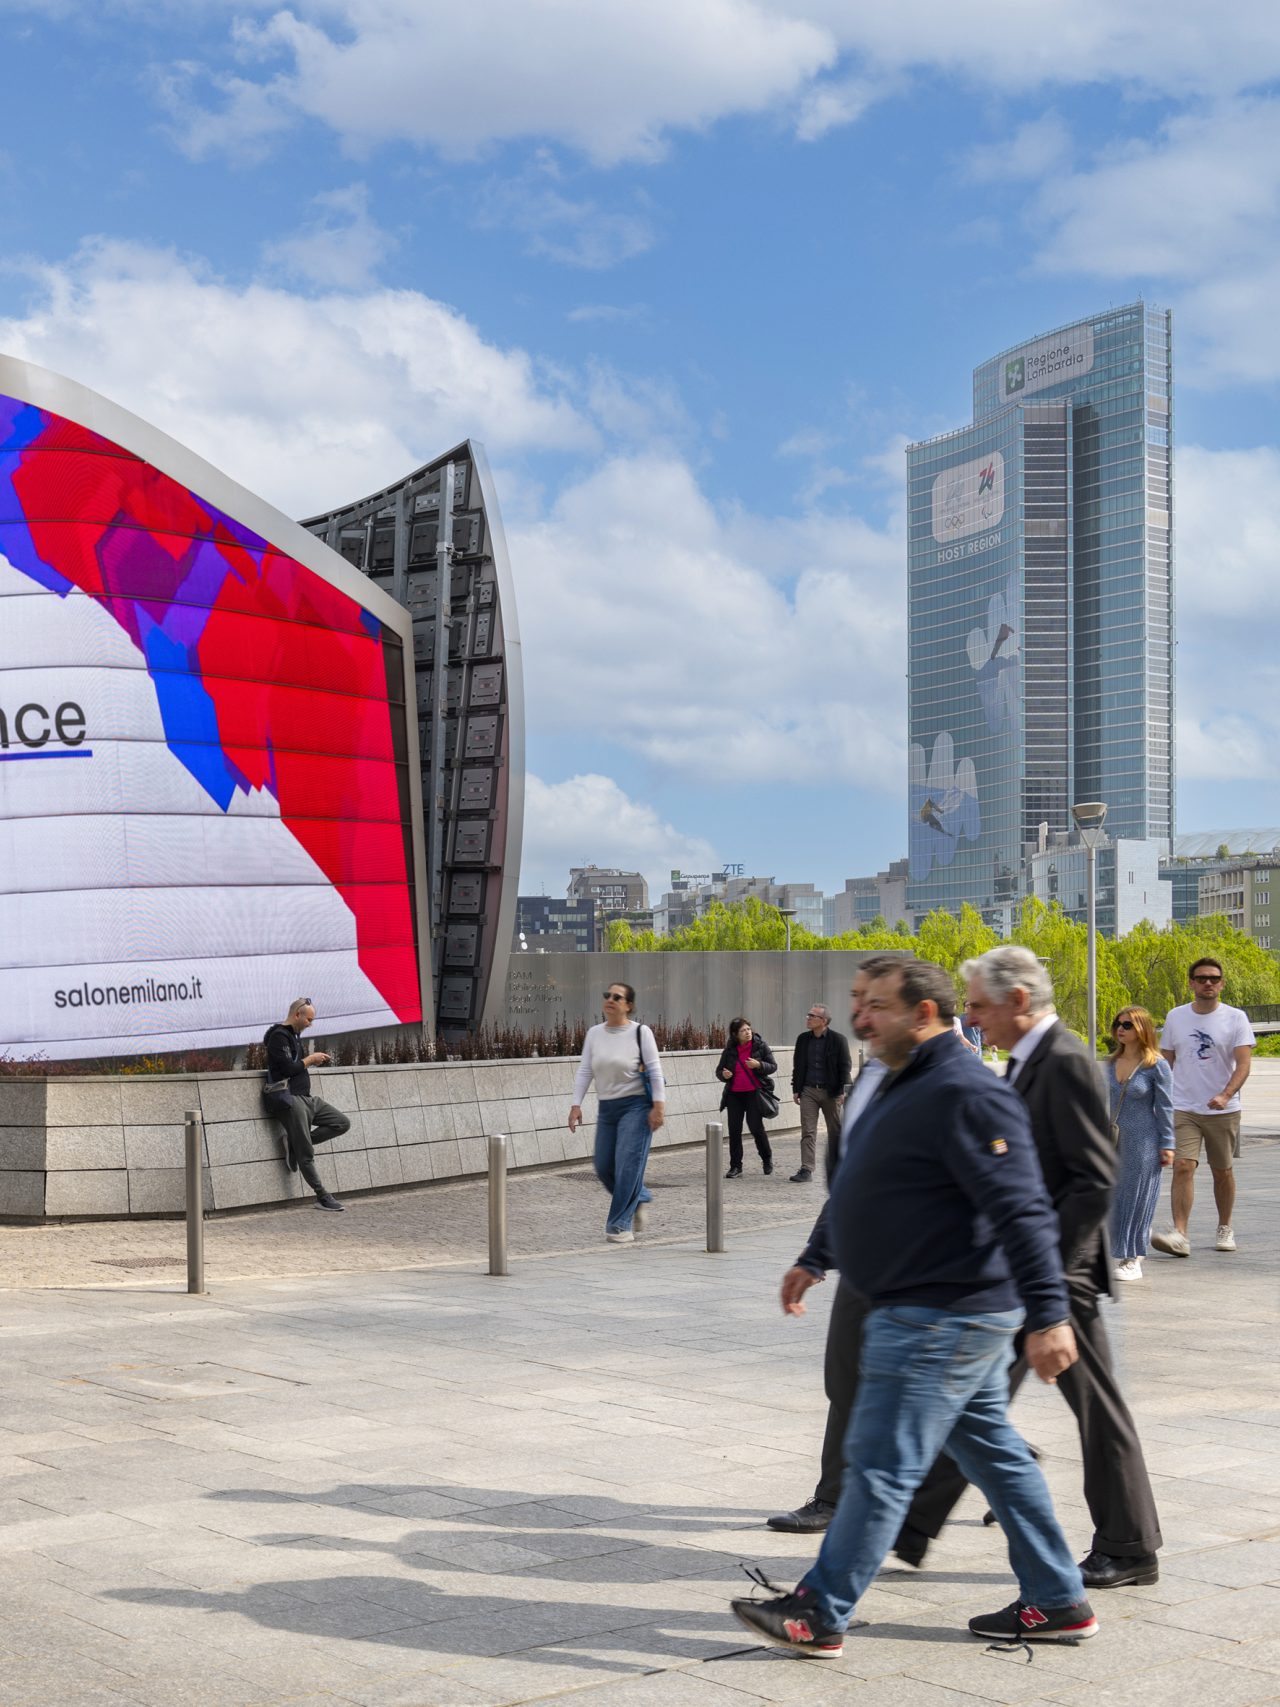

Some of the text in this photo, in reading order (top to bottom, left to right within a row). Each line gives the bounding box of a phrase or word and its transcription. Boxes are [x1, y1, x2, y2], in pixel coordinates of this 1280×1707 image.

[1026, 346, 1070, 369] Regione
[1027, 354, 1084, 381] Lombardia
[937, 532, 1002, 562] HOST REGION
[722, 863, 744, 875] ZTE
[54, 976, 203, 1008] salonemilano.it
